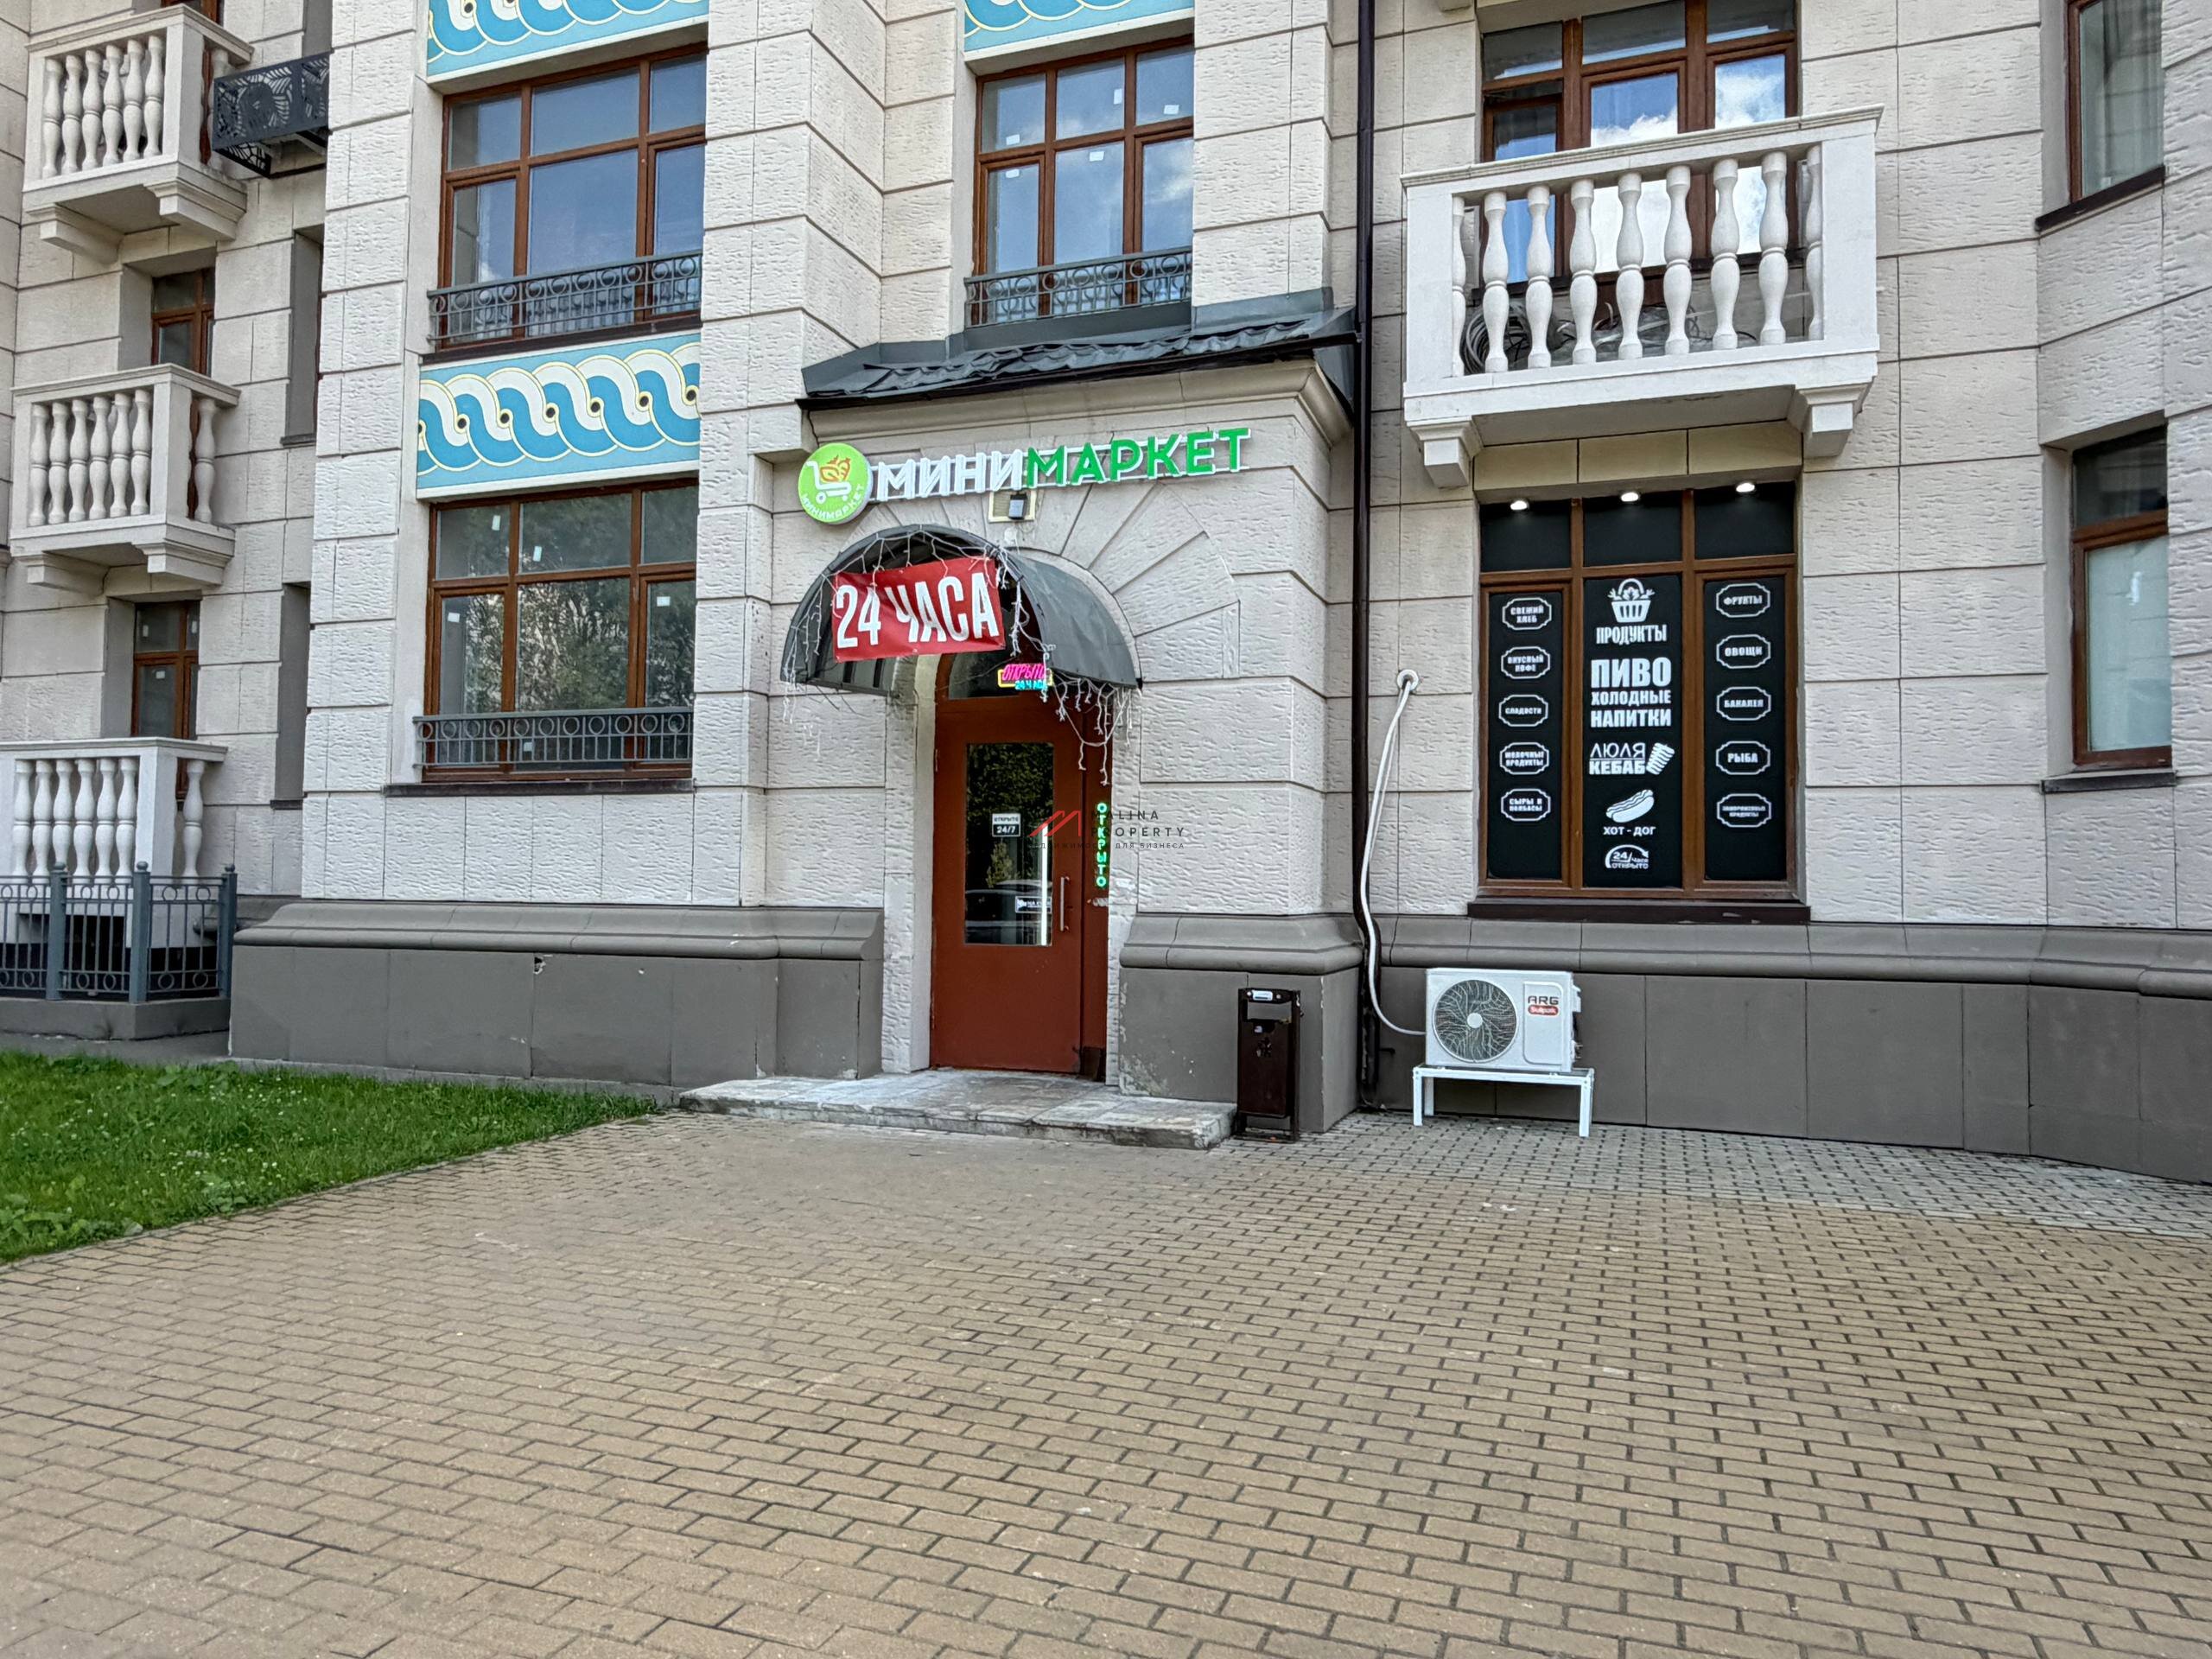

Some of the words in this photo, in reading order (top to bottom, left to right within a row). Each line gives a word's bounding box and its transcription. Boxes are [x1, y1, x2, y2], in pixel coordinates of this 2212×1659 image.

[1723, 594, 1763, 606] ФРУКТЫ
[836, 584, 881, 648] 24
[885, 572, 1000, 643] ЧАСА
[1516, 614, 1538, 624] ХЛЕБ
[1596, 624, 1668, 645] ПРОДУКТЫ
[1724, 646, 1763, 657] ОВОЩИ
[1515, 664, 1536, 673] КОФЕ
[1591, 657, 1672, 688] ПИВО
[1591, 690, 1672, 707] ХОЛОДНЫЕ
[1724, 698, 1764, 709] БАКАЛЕЯ
[1591, 709, 1672, 728] НАПИТКИ
[1590, 742, 1646, 758] ЛЮЛЯ
[1727, 753, 1758, 763] РЫБА
[1589, 760, 1646, 775] КЕБАБ
[996, 825, 1016, 834] 24/7
[1603, 826, 1625, 836] ХОТ
[1633, 826, 1656, 837] ДОГ
[1096, 802, 1108, 887] ОТКРЫТО
[1527, 995, 1560, 1006] ARG
